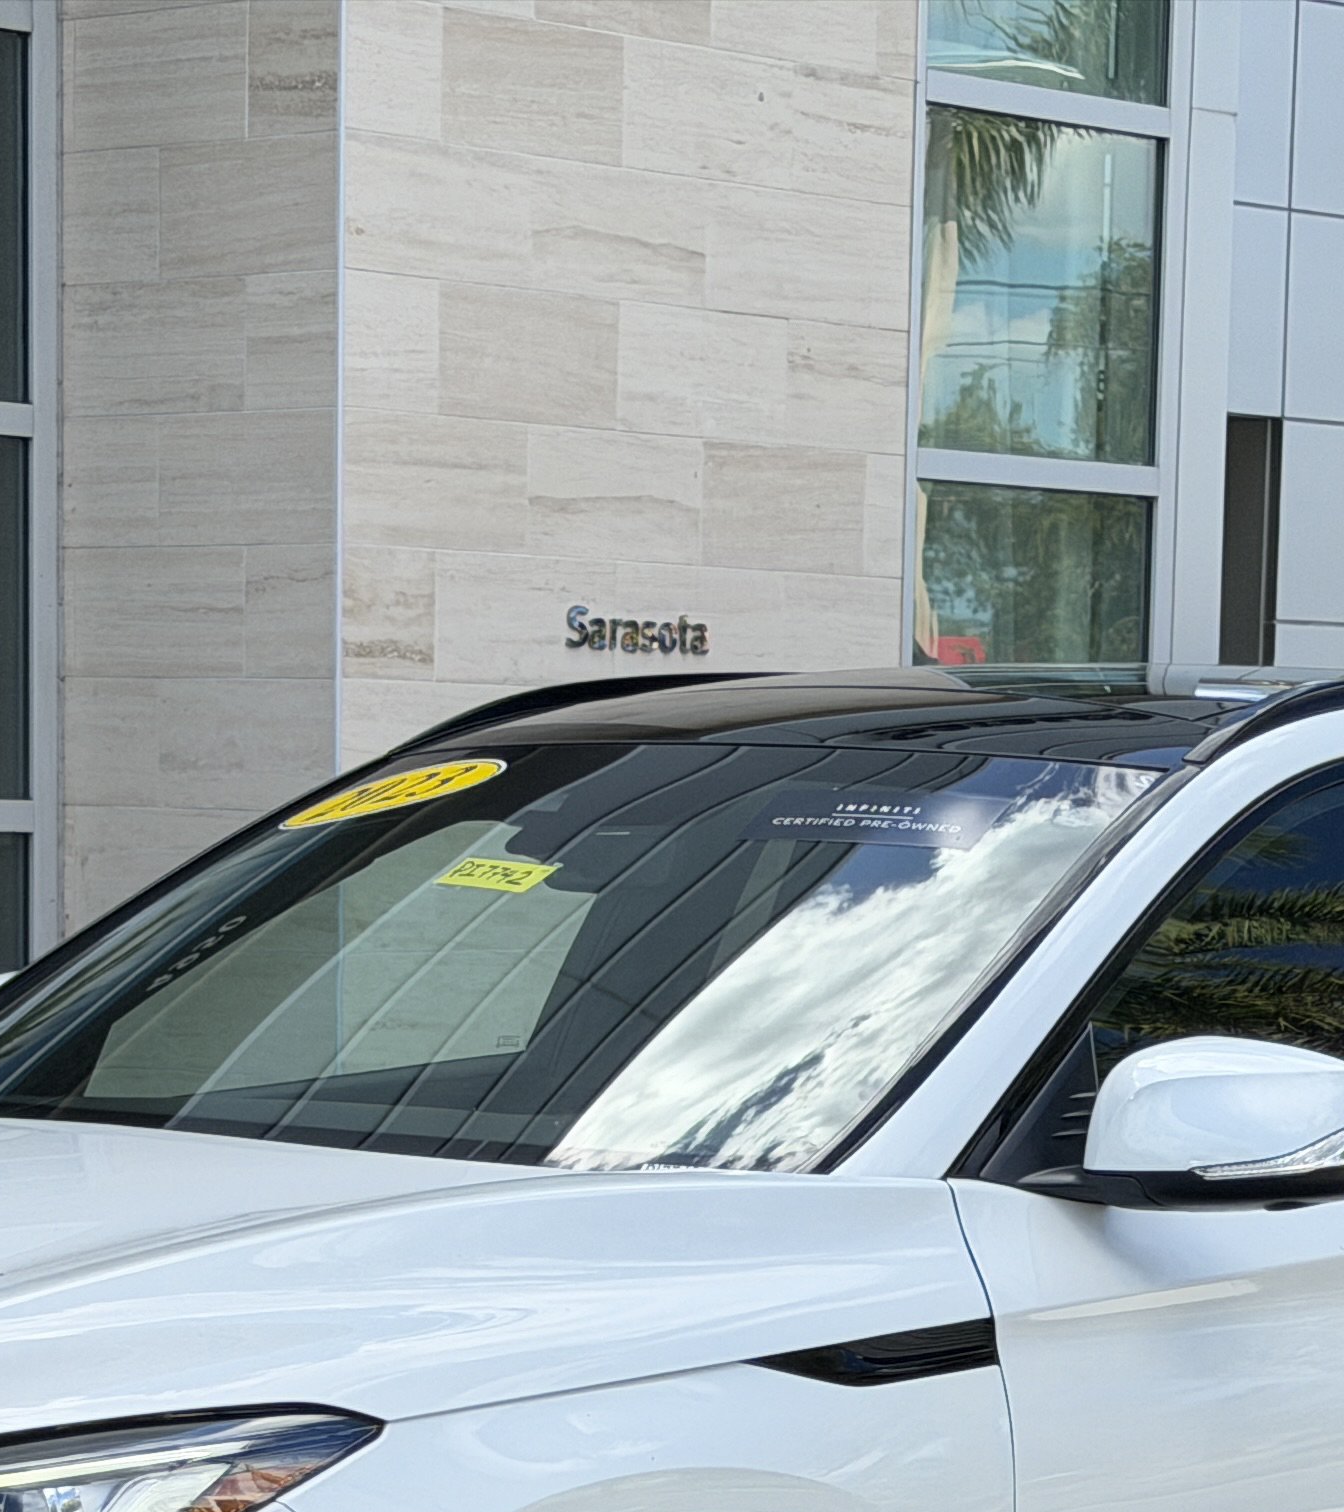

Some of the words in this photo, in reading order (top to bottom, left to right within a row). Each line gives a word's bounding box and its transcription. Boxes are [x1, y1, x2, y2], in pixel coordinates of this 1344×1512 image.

[564, 604, 710, 656] Sarasota
[302, 764, 479, 823] 2023
[835, 803, 921, 815] INFINITI
[771, 816, 856, 828] CERTIFIED
[859, 819, 962, 834] PRE-OWNED
